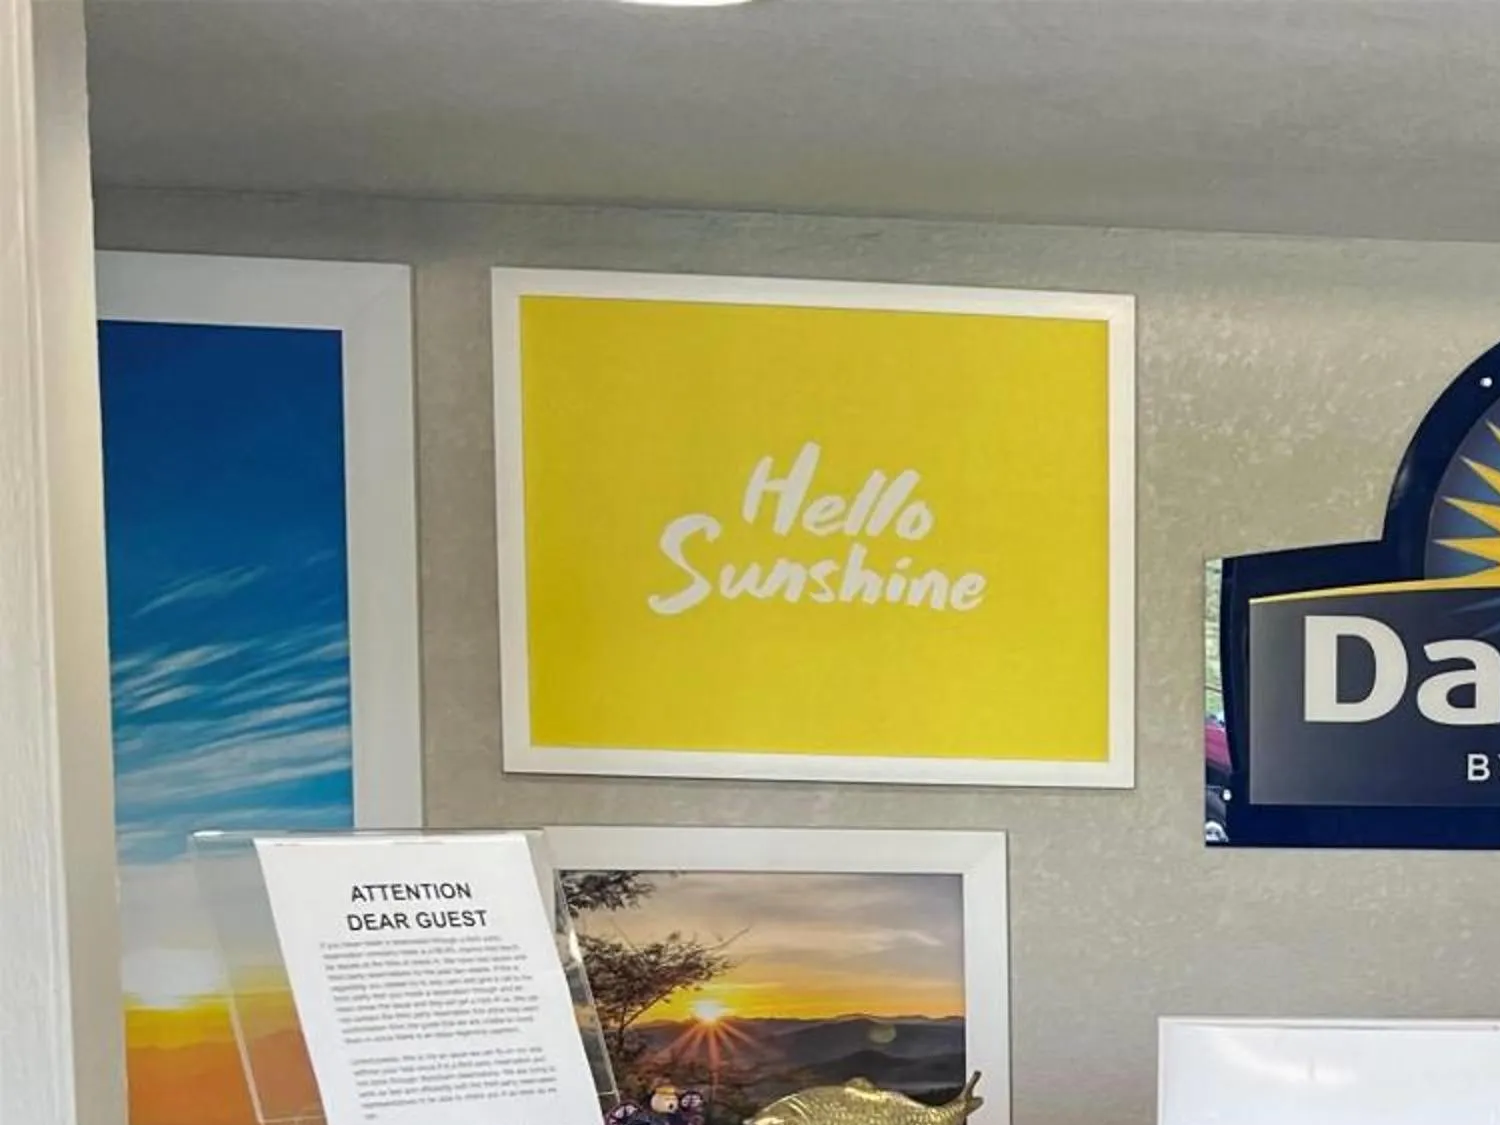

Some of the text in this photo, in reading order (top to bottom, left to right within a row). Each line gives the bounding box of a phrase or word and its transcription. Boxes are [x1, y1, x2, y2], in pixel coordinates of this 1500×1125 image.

[741, 441, 934, 541] Hello
[648, 512, 987, 615] Sunshine
[346, 909, 487, 931] DEAR GUEST
[351, 882, 472, 903] ATTENTION
